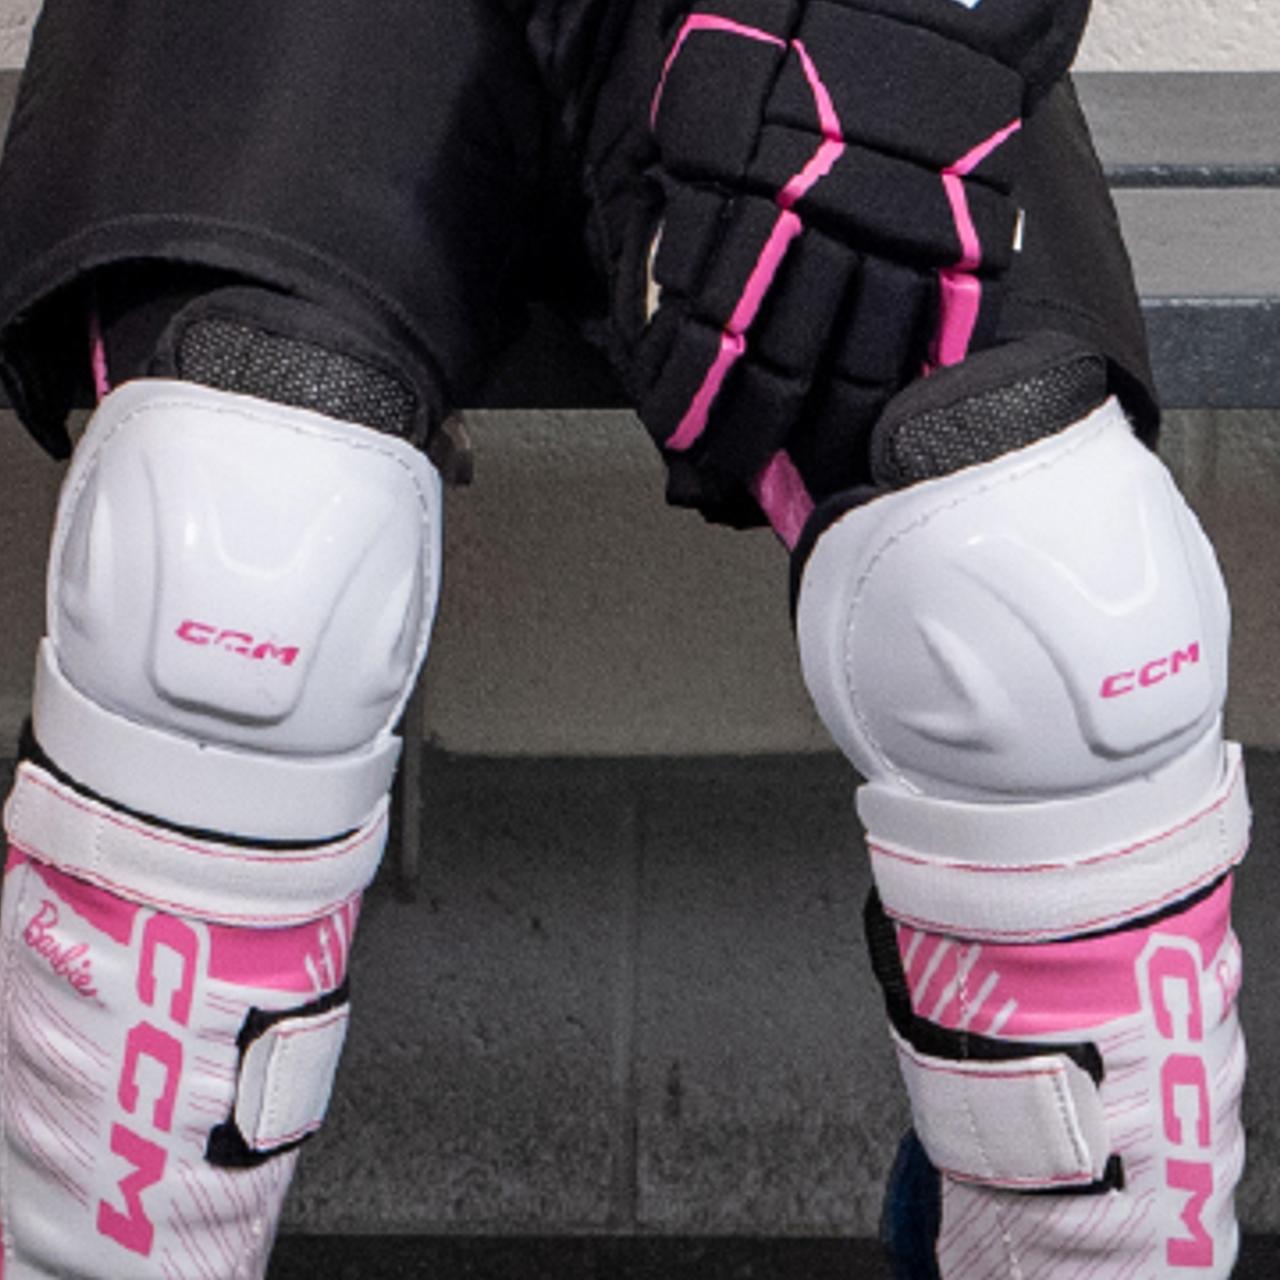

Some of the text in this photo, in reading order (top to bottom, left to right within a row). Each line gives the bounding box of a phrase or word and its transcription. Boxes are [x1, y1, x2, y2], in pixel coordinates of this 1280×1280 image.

[175, 619, 300, 667] CCM
[1099, 641, 1200, 699] CCM
[23, 900, 97, 997] Barbie
[96, 912, 201, 1258] CCM
[1147, 946, 1214, 1269] CCM
